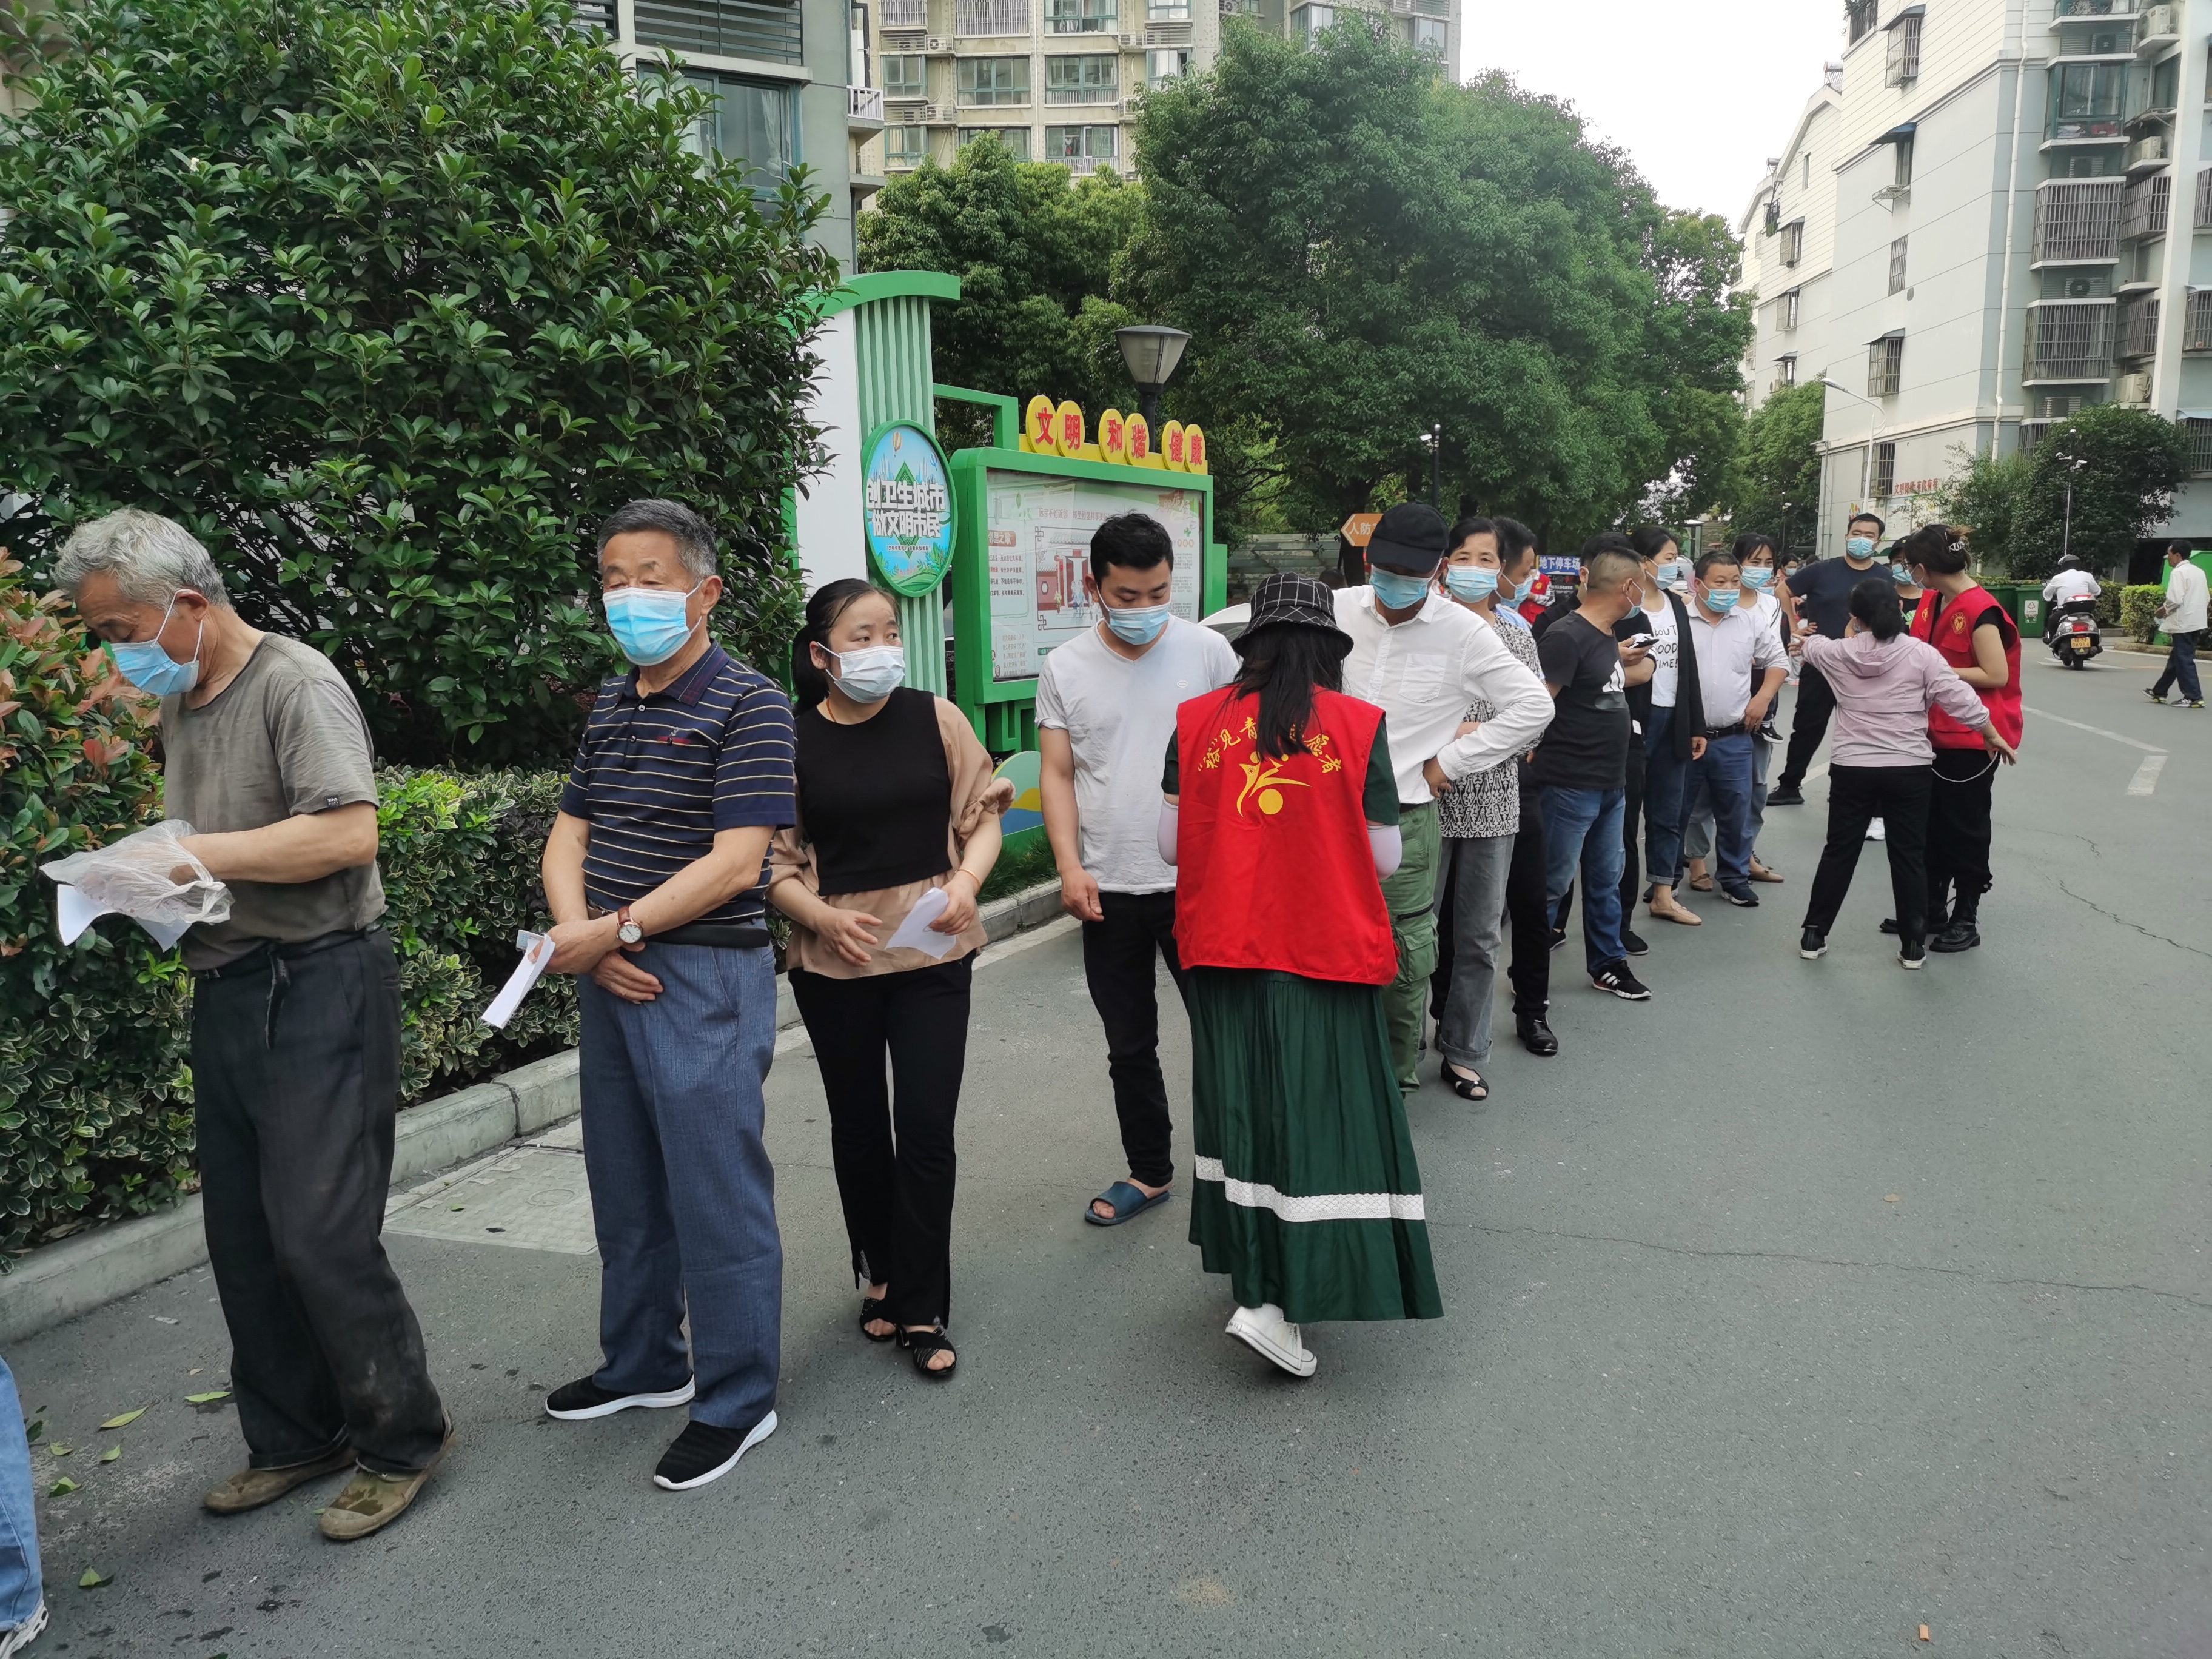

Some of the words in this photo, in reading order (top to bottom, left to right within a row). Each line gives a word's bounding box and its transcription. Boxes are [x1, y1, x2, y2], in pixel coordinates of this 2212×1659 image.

[1036, 407, 1081, 449] 文明
[1107, 418, 1147, 458] 和谐
[1169, 428, 1203, 466] 健康
[866, 478, 946, 511] 创卫生城市
[1039, 508, 1068, 519] 远亲不如近邻
[872, 510, 941, 538] 做文明市民
[1349, 522, 1377, 535] 人防
[988, 531, 1011, 545] 邻里之歌
[1539, 556, 1580, 570] 地下停车场
[1656, 643, 1678, 654] OOD
